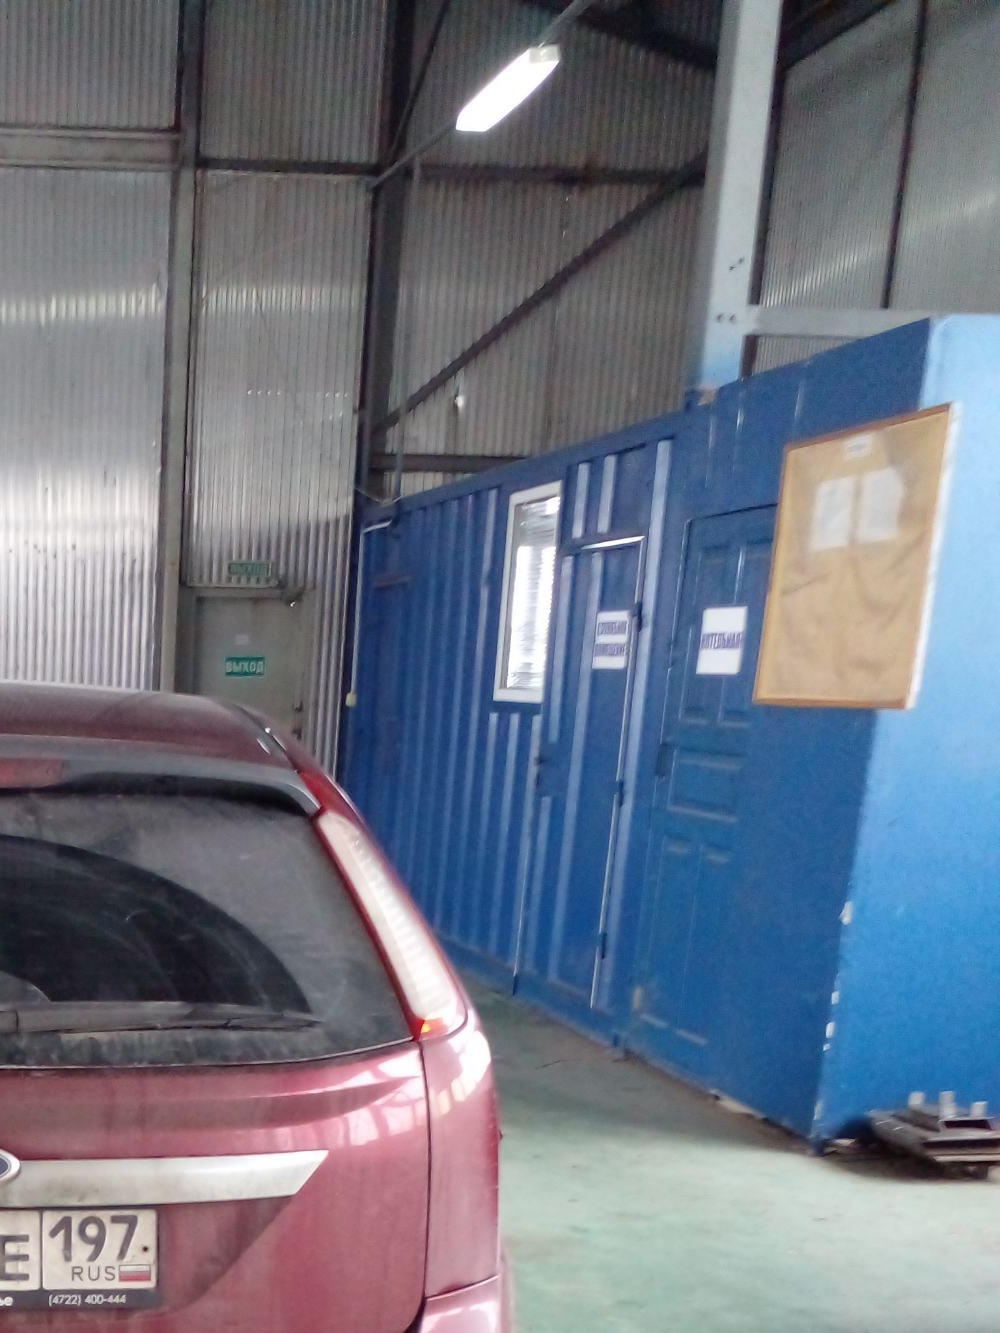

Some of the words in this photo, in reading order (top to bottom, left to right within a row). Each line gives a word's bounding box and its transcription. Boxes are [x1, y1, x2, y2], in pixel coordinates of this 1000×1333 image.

[225, 660, 264, 673] ВЫХОД
[48, 1214, 138, 1263] 197
[70, 1265, 116, 1282] RUS
[48, 1294, 81, 1306] (4722)
[84, 1294, 127, 1305] 400-444
